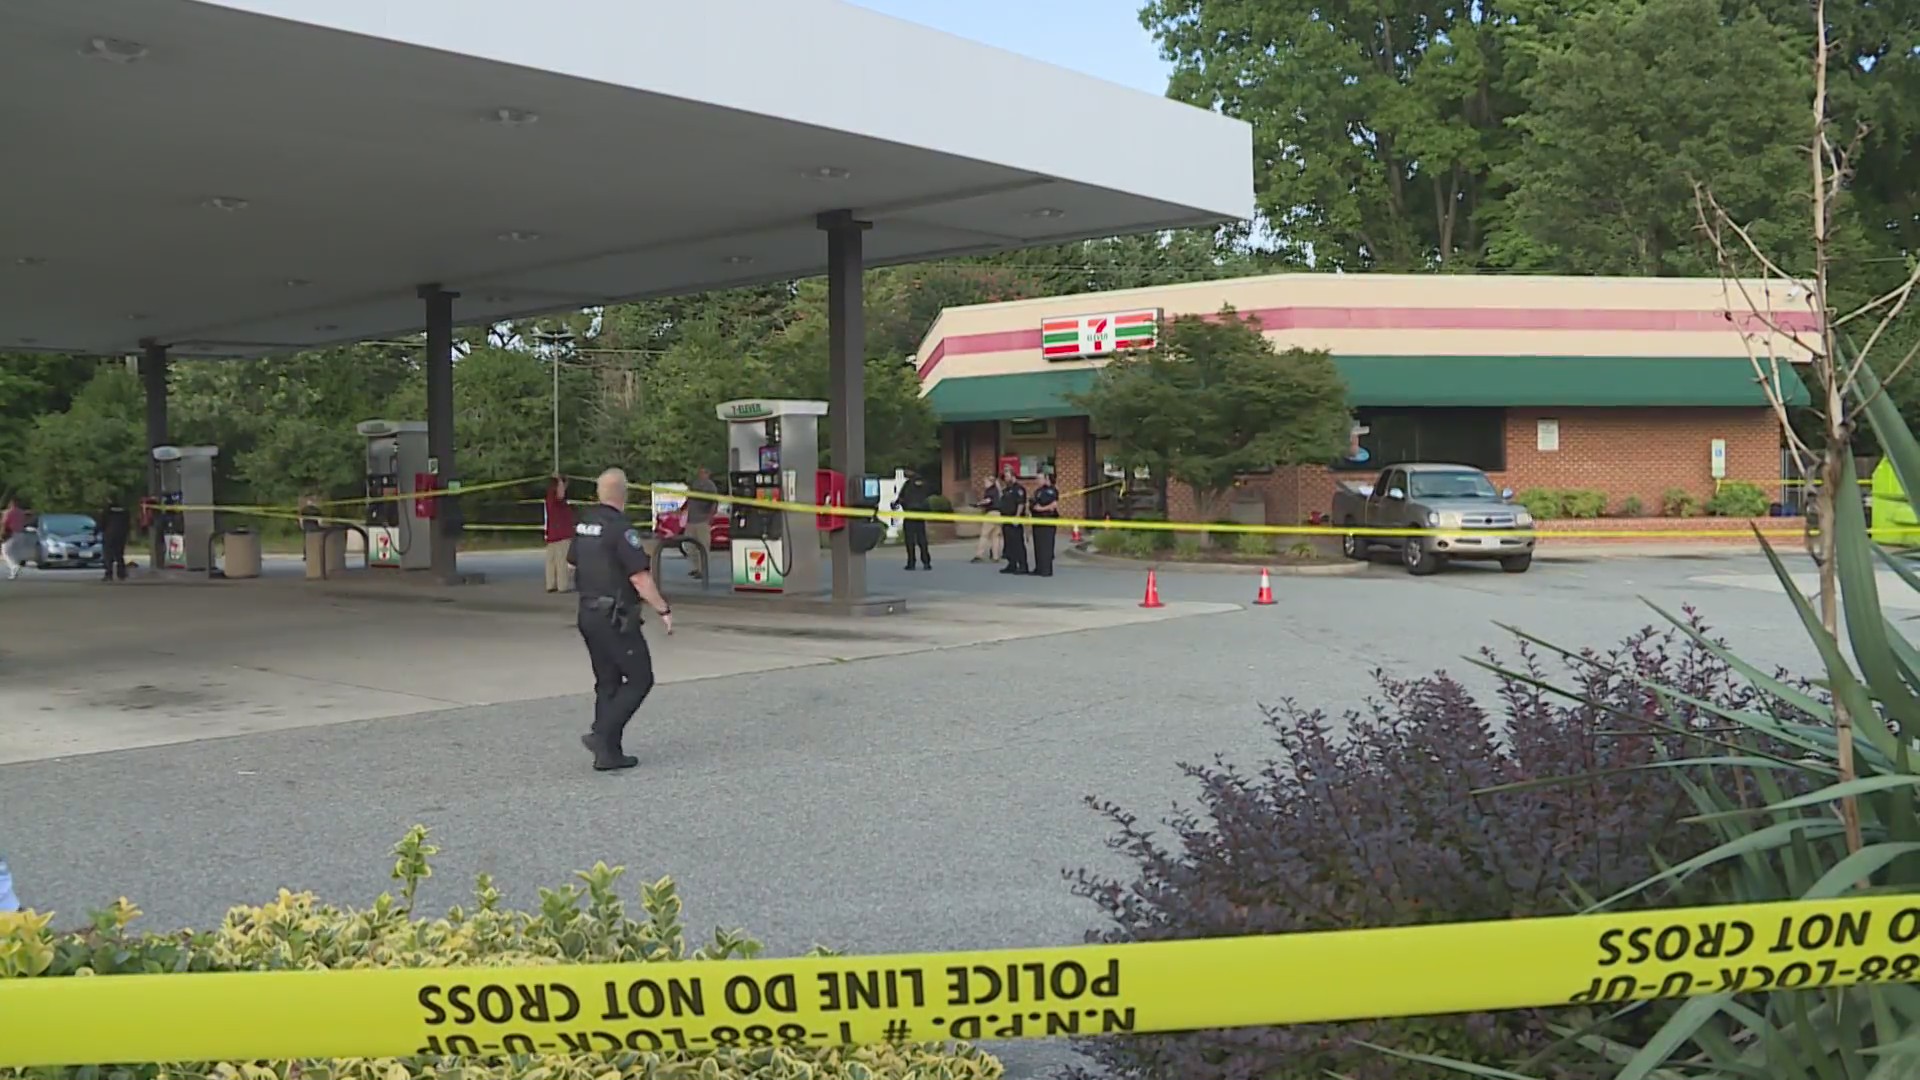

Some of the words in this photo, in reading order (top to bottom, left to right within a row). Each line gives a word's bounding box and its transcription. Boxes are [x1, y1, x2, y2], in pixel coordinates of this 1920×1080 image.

[1087, 318, 1107, 351] 7
[750, 551, 766, 582] 7
[1597, 921, 1754, 967] CROSS
[1769, 911, 1872, 953] NOT
[1888, 908, 1920, 943] O
[601, 977, 705, 1020] NOT
[725, 974, 798, 1015] DO
[817, 969, 925, 1012] LINE
[946, 959, 1119, 1005] POLICE
[418, 983, 581, 1025] CROSS
